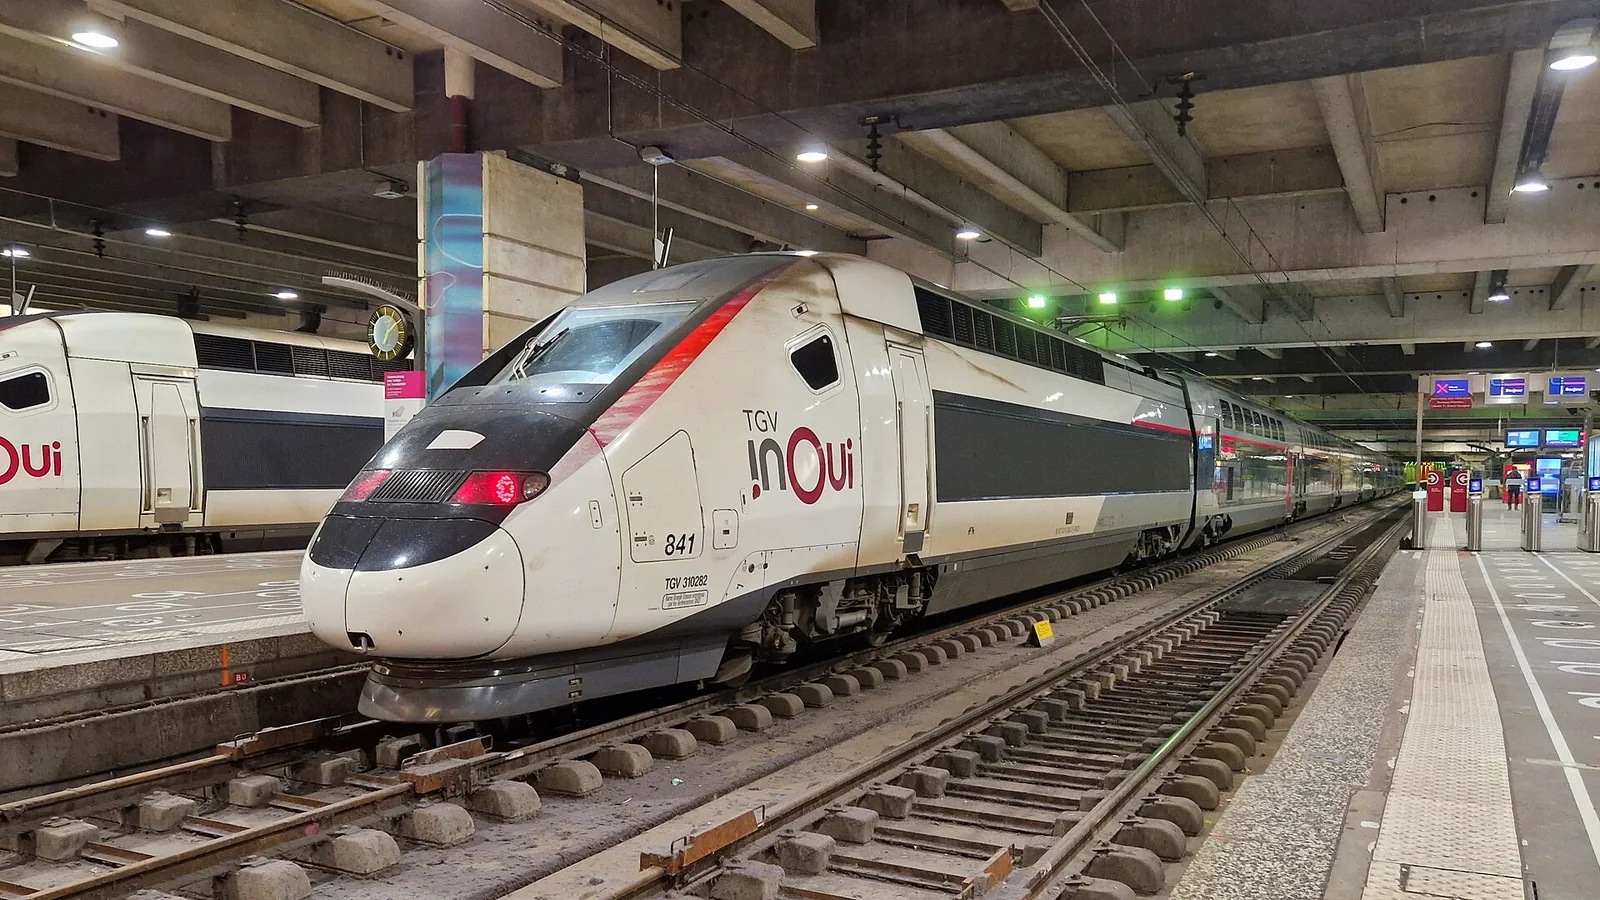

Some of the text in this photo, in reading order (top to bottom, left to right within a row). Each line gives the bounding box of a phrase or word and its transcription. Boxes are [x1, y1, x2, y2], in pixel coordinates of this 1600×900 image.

[742, 409, 778, 433] TGV
[665, 533, 695, 556] 841
[665, 574, 708, 590] TGV 310282
